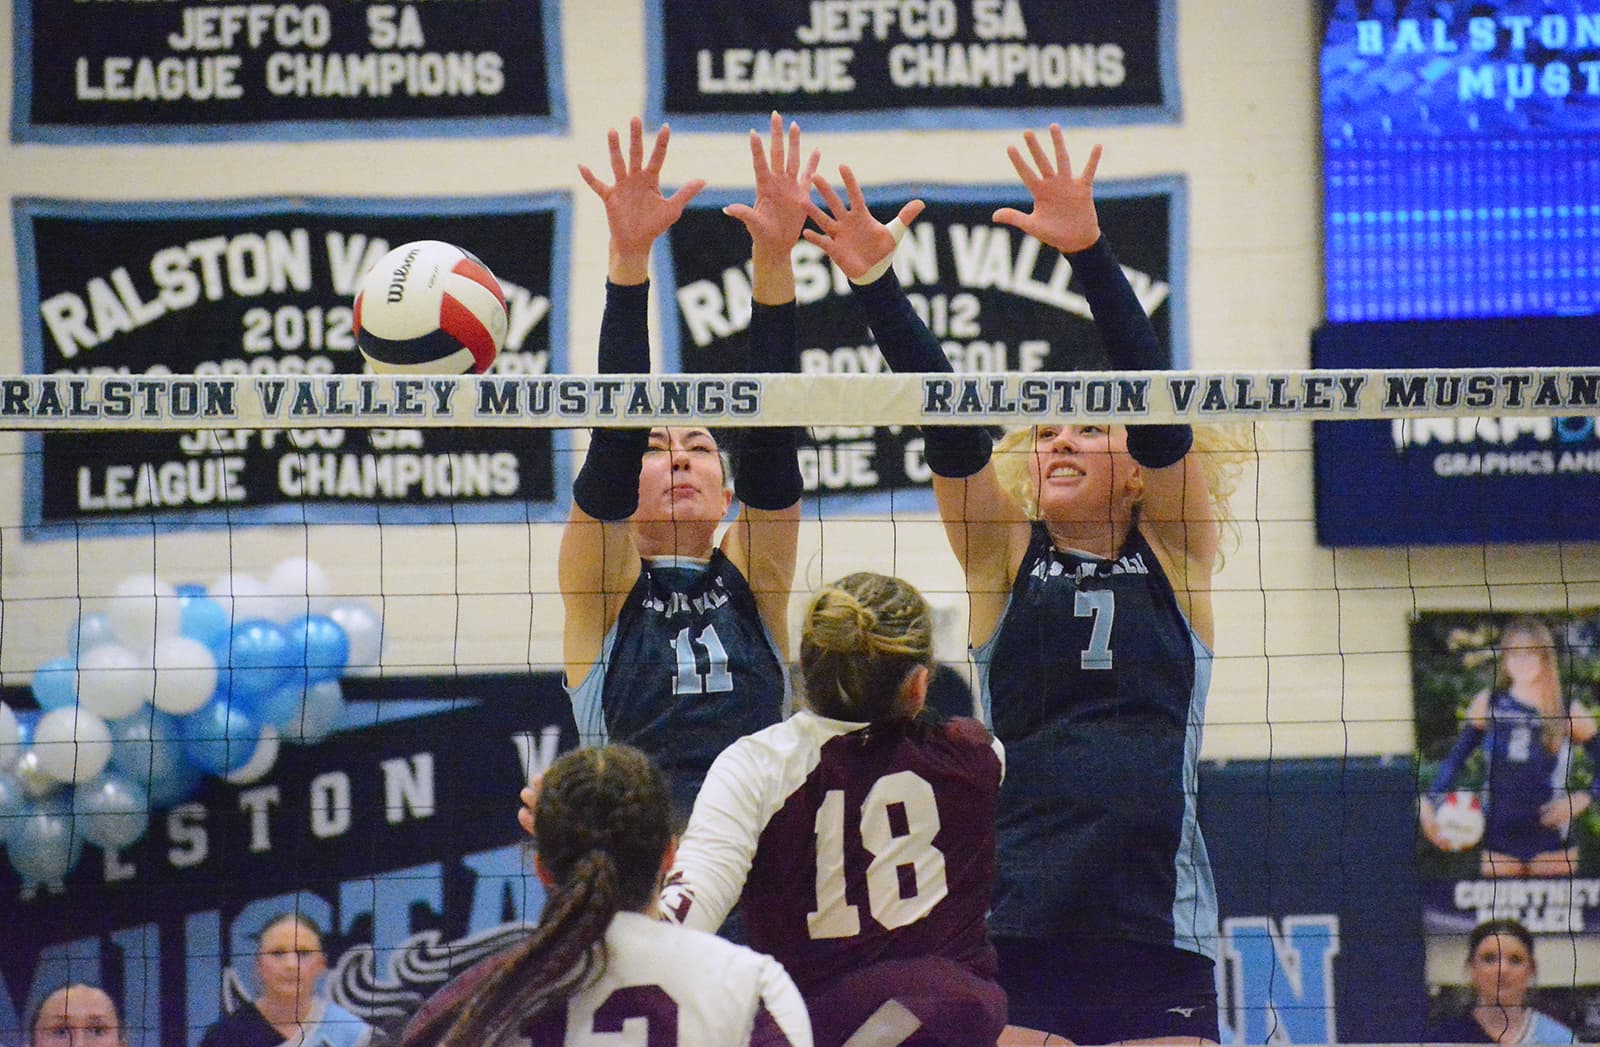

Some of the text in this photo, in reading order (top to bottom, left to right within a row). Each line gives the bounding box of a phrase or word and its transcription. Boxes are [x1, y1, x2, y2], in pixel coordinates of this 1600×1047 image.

[168, 5, 425, 51] JEFFCO 5A
[797, 0, 1027, 41] JEFFCO 5A
[76, 52, 505, 100] LEAGUE CHAMPIONS
[698, 43, 1126, 94] LEAGUE CHAMPIONS
[41, 229, 312, 358] RALSTON
[387, 248, 420, 304] Wilson
[242, 305, 357, 353] 2012
[2, 377, 760, 418] RALSTON VALLEY MUSTANGS
[924, 379, 1147, 414] RALSTON
[1172, 376, 1362, 410] VALLEY
[77, 453, 520, 511] LEAGUE CHAMPIONS
[1073, 589, 1115, 670] 7
[669, 623, 734, 695] 11
[807, 770, 949, 940] 18
